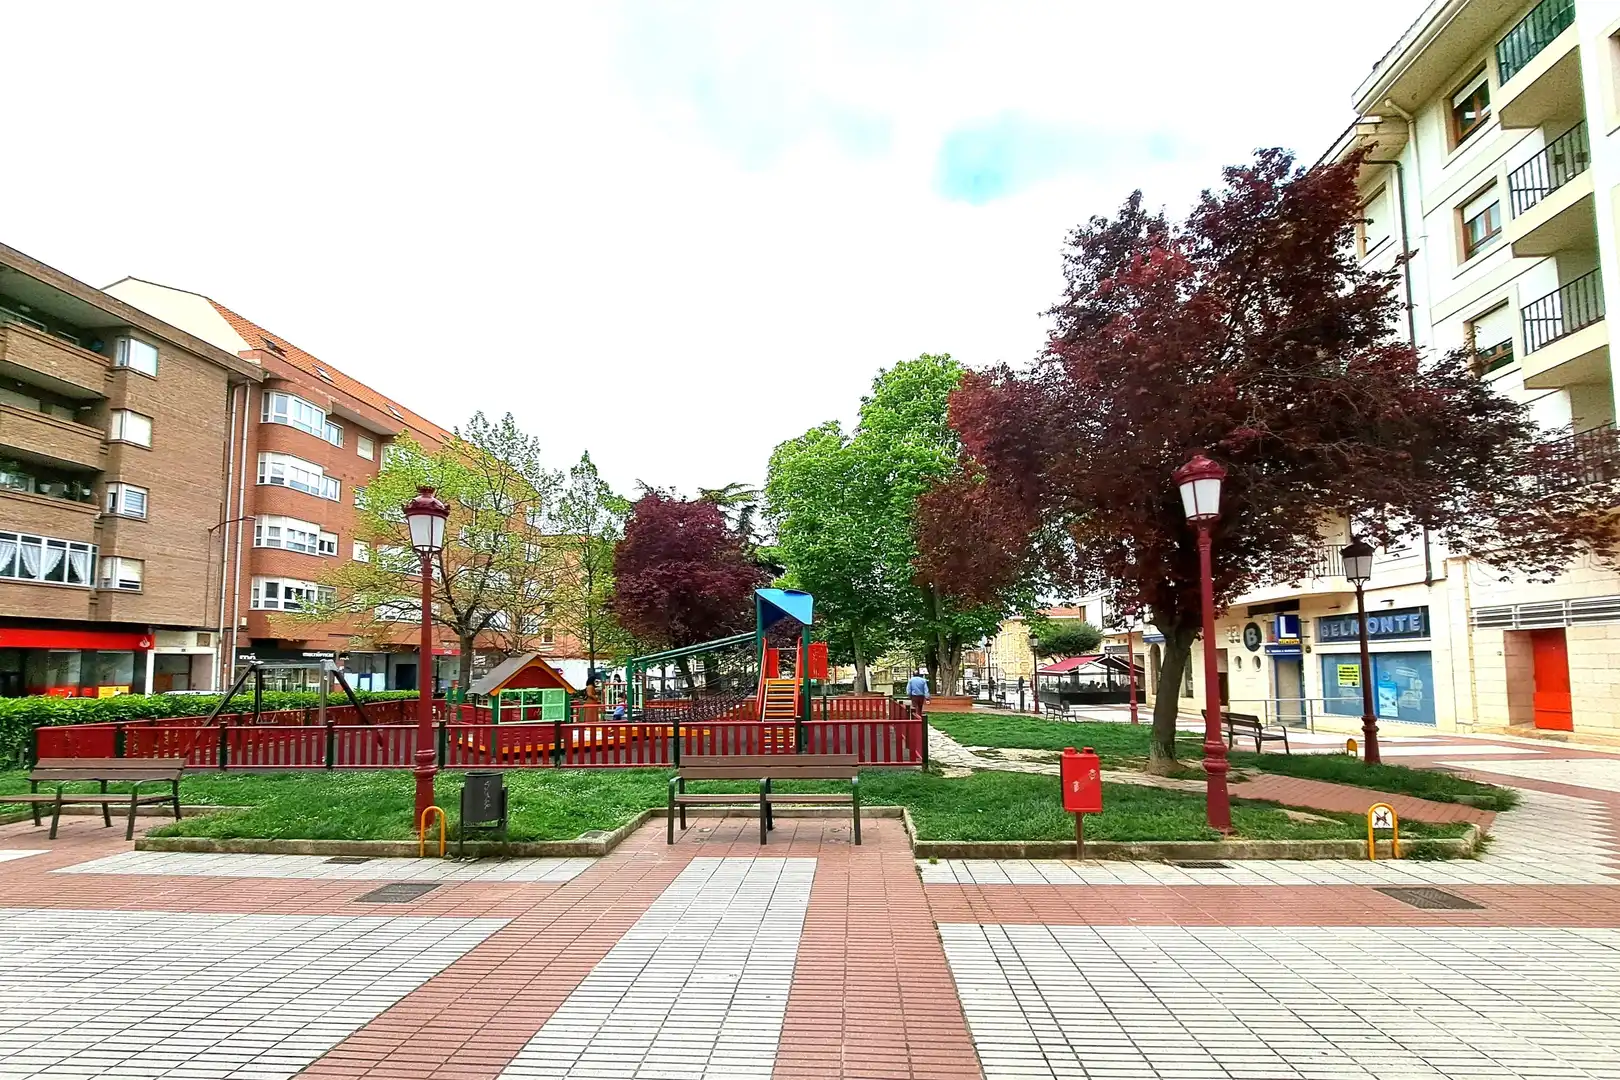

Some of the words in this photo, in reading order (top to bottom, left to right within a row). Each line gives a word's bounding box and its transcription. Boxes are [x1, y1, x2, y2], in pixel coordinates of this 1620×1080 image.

[1279, 616, 1297, 638] L
[1321, 613, 1421, 637] BELMONTE
[1245, 627, 1258, 647] B
